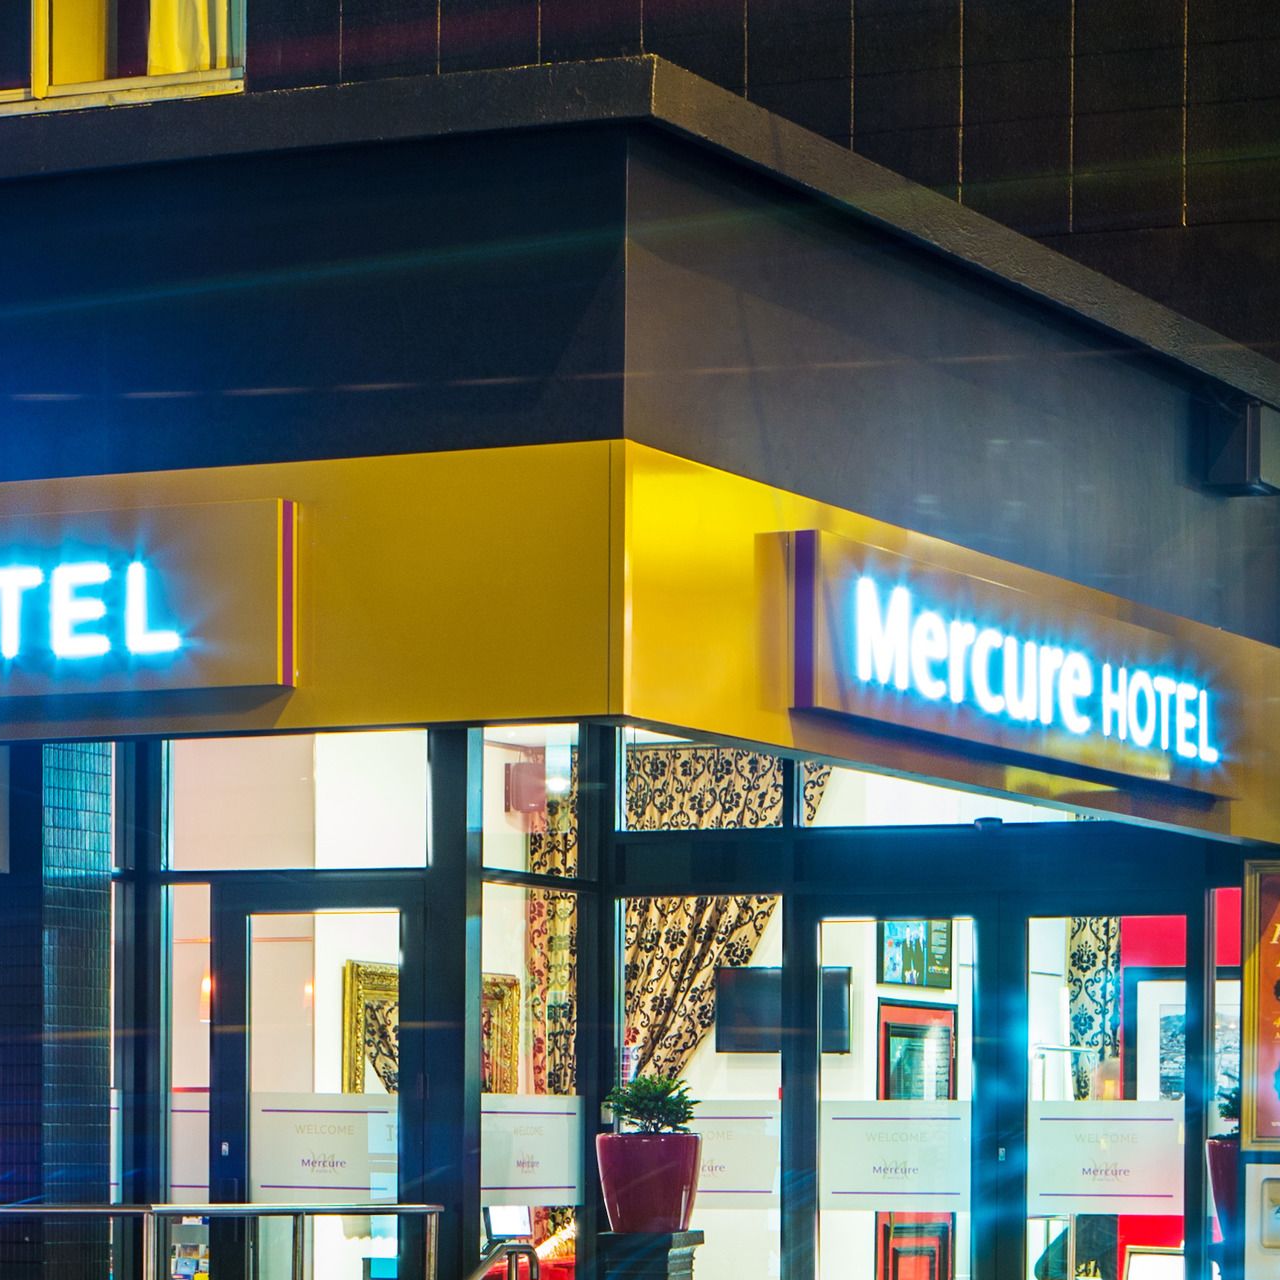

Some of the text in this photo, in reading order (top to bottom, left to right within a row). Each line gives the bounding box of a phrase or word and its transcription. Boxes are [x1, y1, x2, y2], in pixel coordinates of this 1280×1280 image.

[855, 576, 1219, 763] Mercure HOTEL
[294, 1124, 355, 1136] WELCOME
[864, 1131, 928, 1143] WELCOME
[301, 1158, 347, 1168] Mercure
[872, 1165, 919, 1175] Mercure
[1081, 1167, 1131, 1177] Mercure
